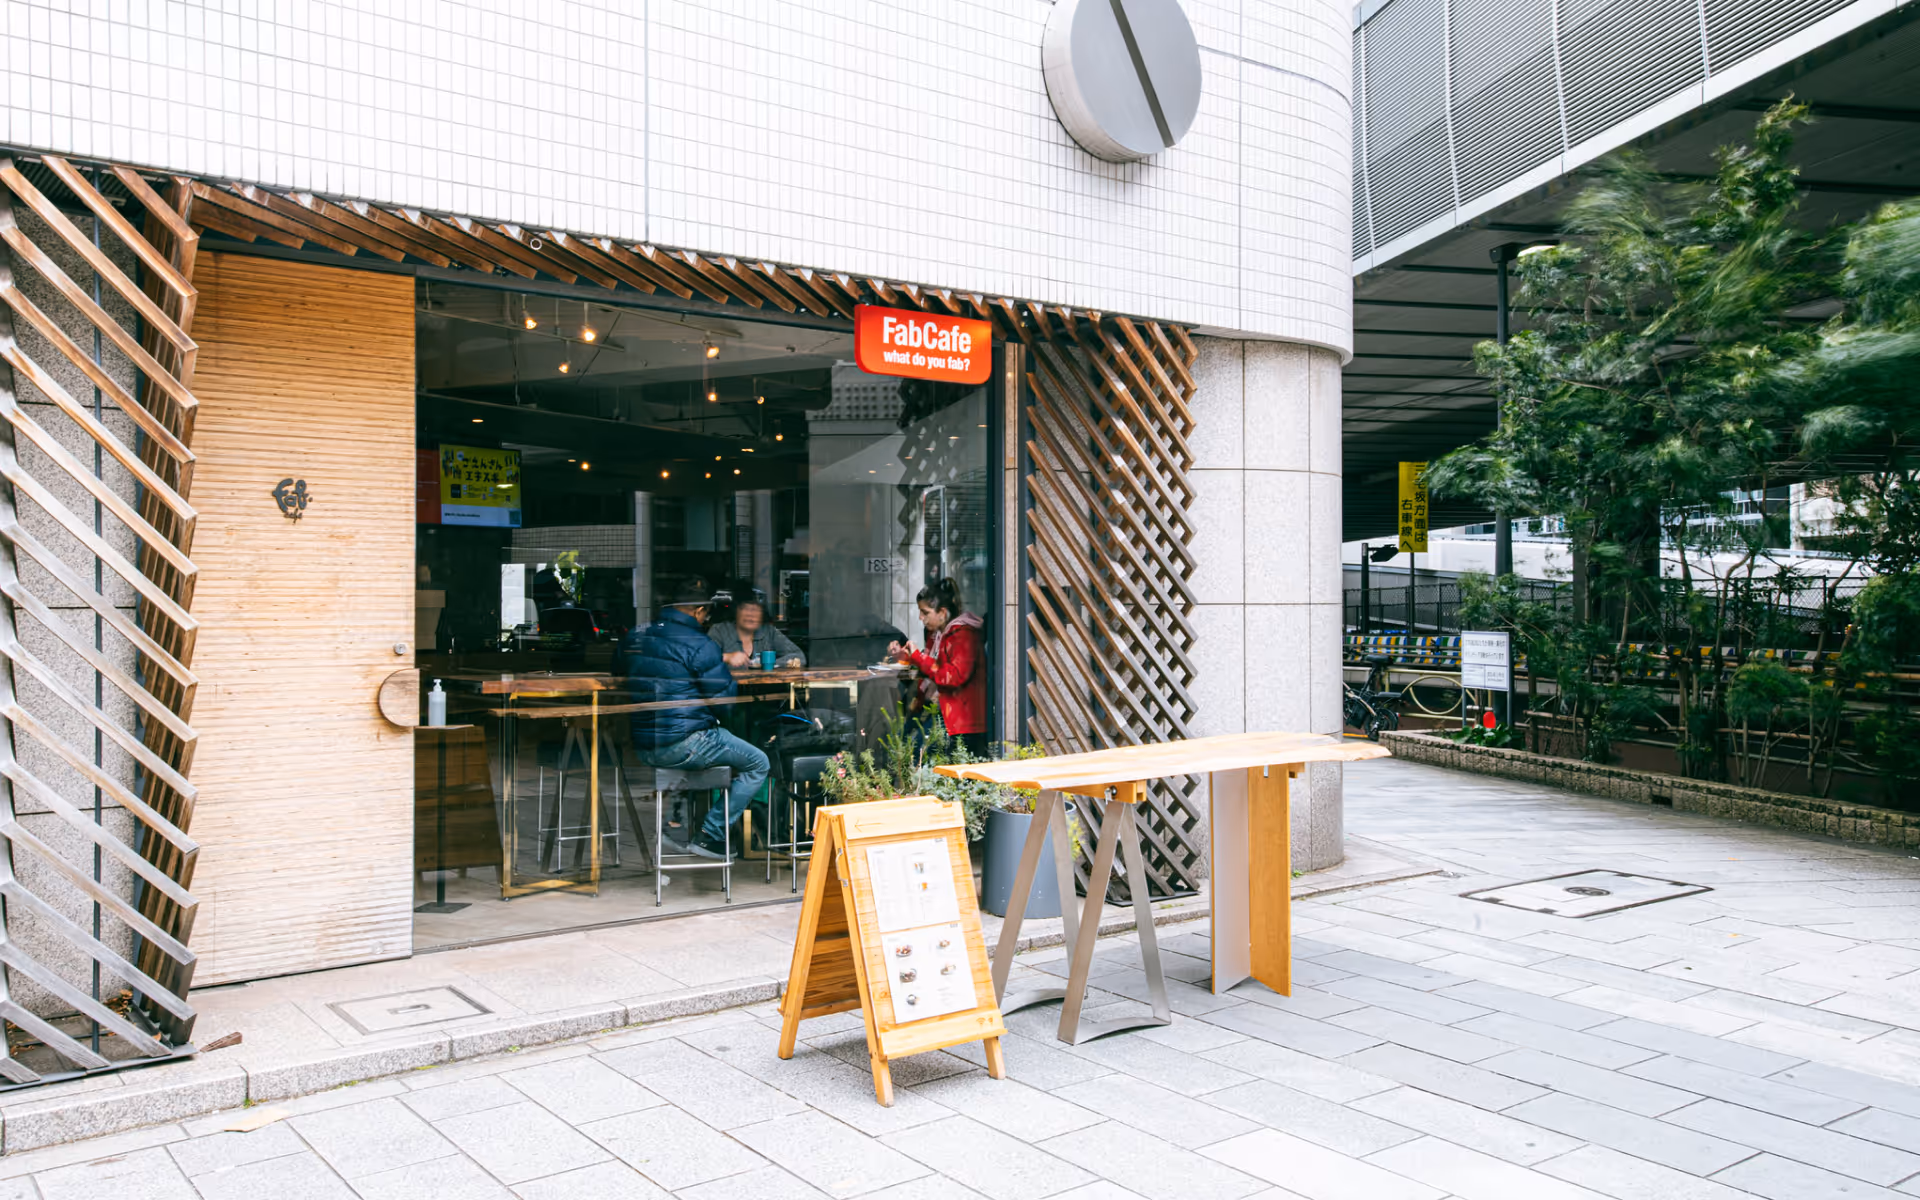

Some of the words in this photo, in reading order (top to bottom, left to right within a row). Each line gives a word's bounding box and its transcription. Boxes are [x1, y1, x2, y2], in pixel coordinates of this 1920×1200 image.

[883, 316, 972, 353] FabCafe
[883, 350, 910, 364] what
[912, 352, 926, 366] do
[927, 356, 946, 370] you
[947, 356, 971, 371] fab?
[1401, 499, 1413, 551] 右車線へ
